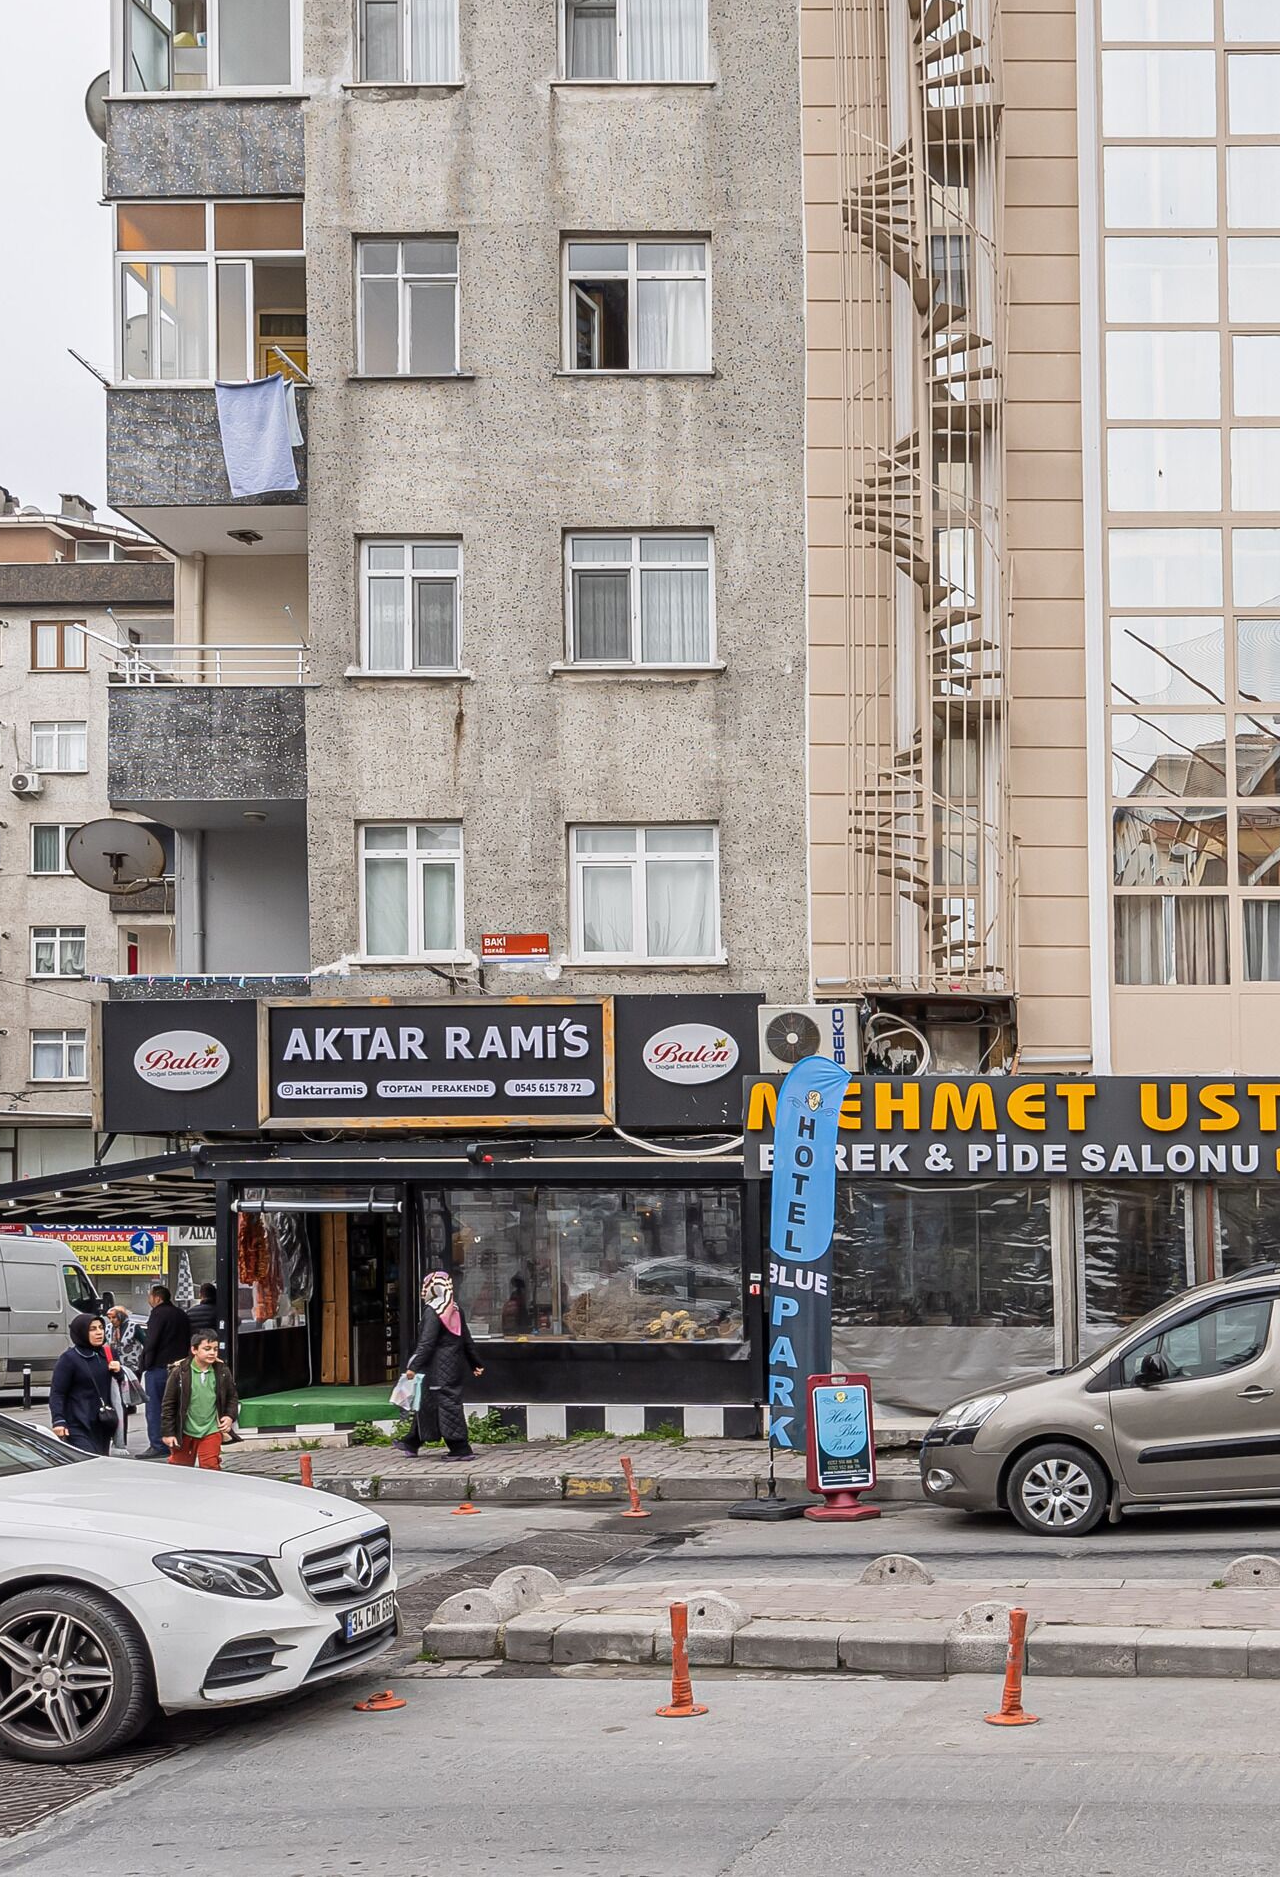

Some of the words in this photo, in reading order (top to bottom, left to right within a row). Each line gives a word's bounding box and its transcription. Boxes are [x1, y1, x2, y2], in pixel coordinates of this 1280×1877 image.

[484, 936, 506, 946] BAKİ
[832, 1008, 845, 1065] BEKO
[283, 1027, 428, 1061] AKTAR
[140, 1048, 222, 1070] Balen
[648, 1041, 730, 1063] Balen
[147, 1070, 167, 1078] Doğal
[168, 1069, 191, 1077] Destek
[655, 1063, 675, 1071] Doğal
[294, 1085, 364, 1096] aktarramis
[382, 1085, 423, 1094] TOPTAN
[431, 1084, 490, 1093] PERAKENDE
[515, 1083, 537, 1093] 0545
[539, 1083, 554, 1093] 615
[557, 1083, 569, 1093] 78
[570, 1083, 582, 1093] 72
[759, 1143, 910, 1172] REK
[924, 1144, 954, 1172] &
[969, 1134, 1068, 1172] PİDE
[1081, 1144, 1259, 1173] SALONU
[784, 1115, 816, 1254] HOTEL
[67, 1234, 116, 1242] DOLAYISIYLA
[112, 1254, 149, 1262] GELMEDİN
[769, 1262, 828, 1296] BLUE
[769, 1295, 800, 1448] PARK
[824, 1409, 863, 1424] Hotel
[834, 1424, 864, 1438] Blue
[826, 1439, 856, 1452] Park
[352, 1610, 363, 1633] 34
